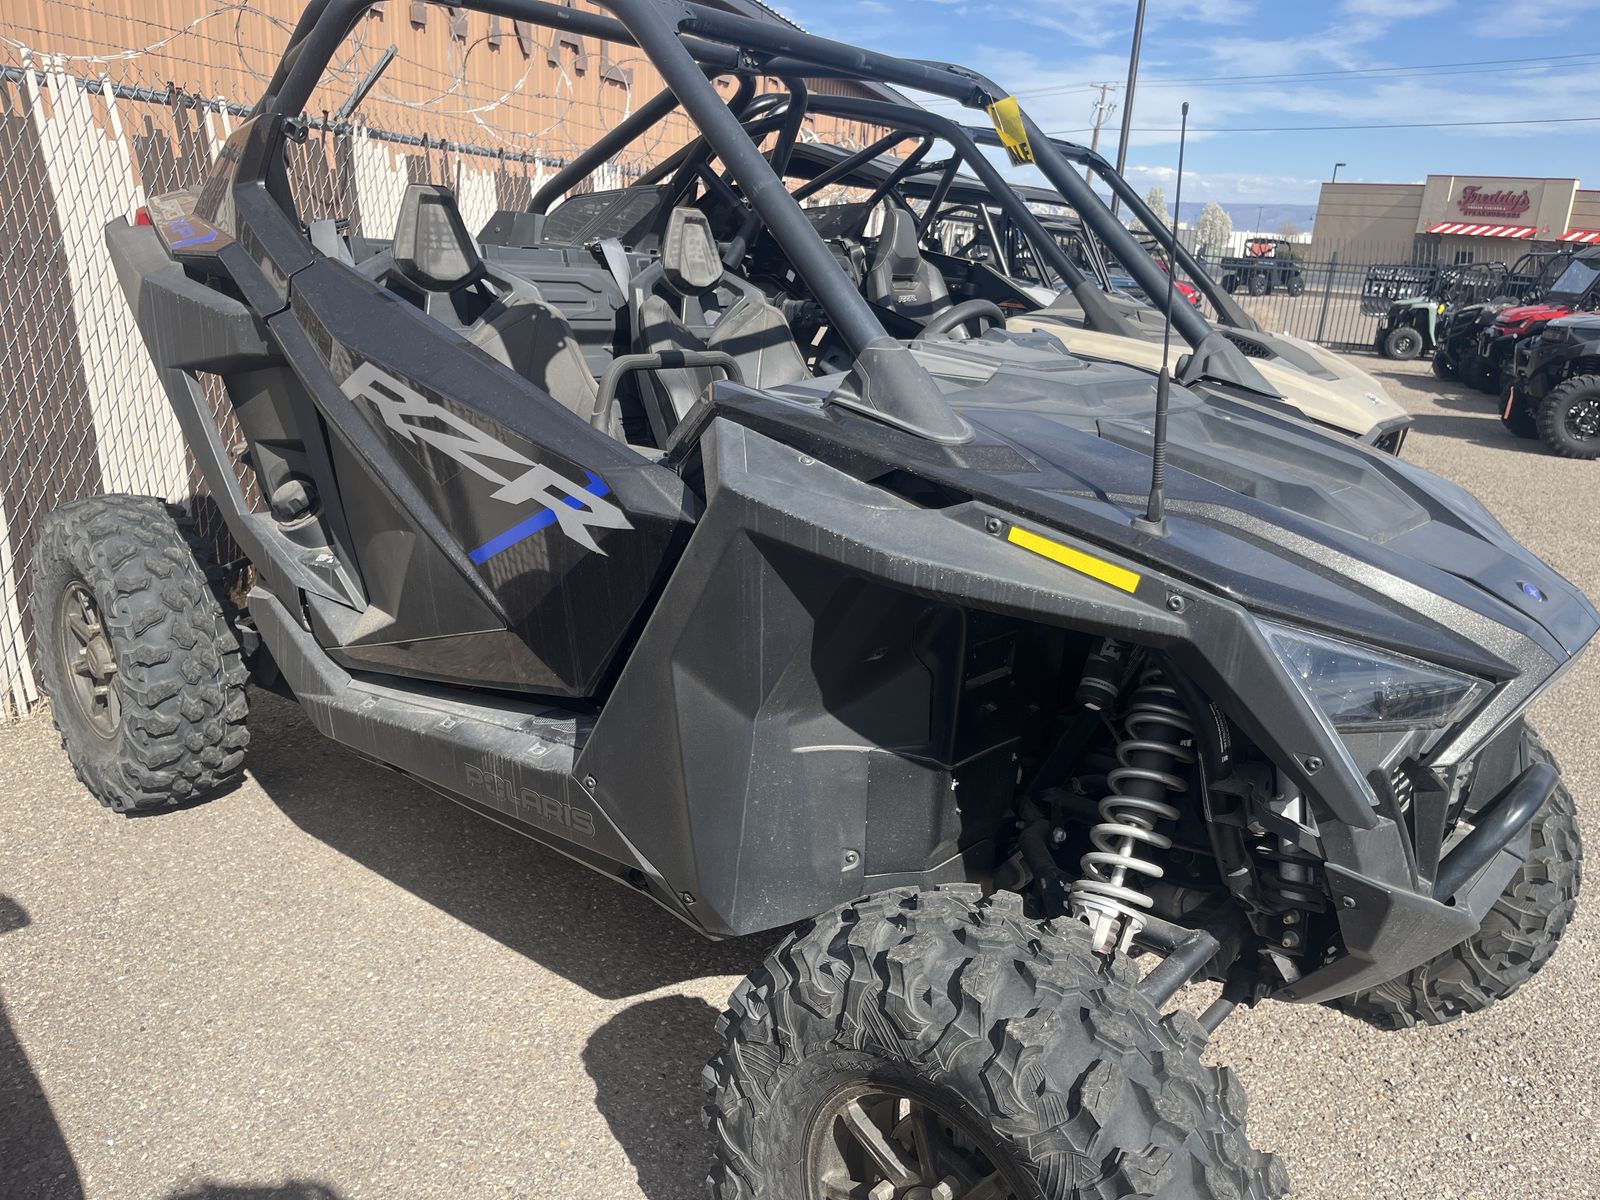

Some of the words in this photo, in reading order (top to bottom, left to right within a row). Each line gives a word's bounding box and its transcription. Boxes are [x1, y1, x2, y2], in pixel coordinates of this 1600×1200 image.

[1457, 186, 1530, 213] Freddy's
[340, 361, 635, 557] RZR
[464, 762, 596, 839] POLARIS
